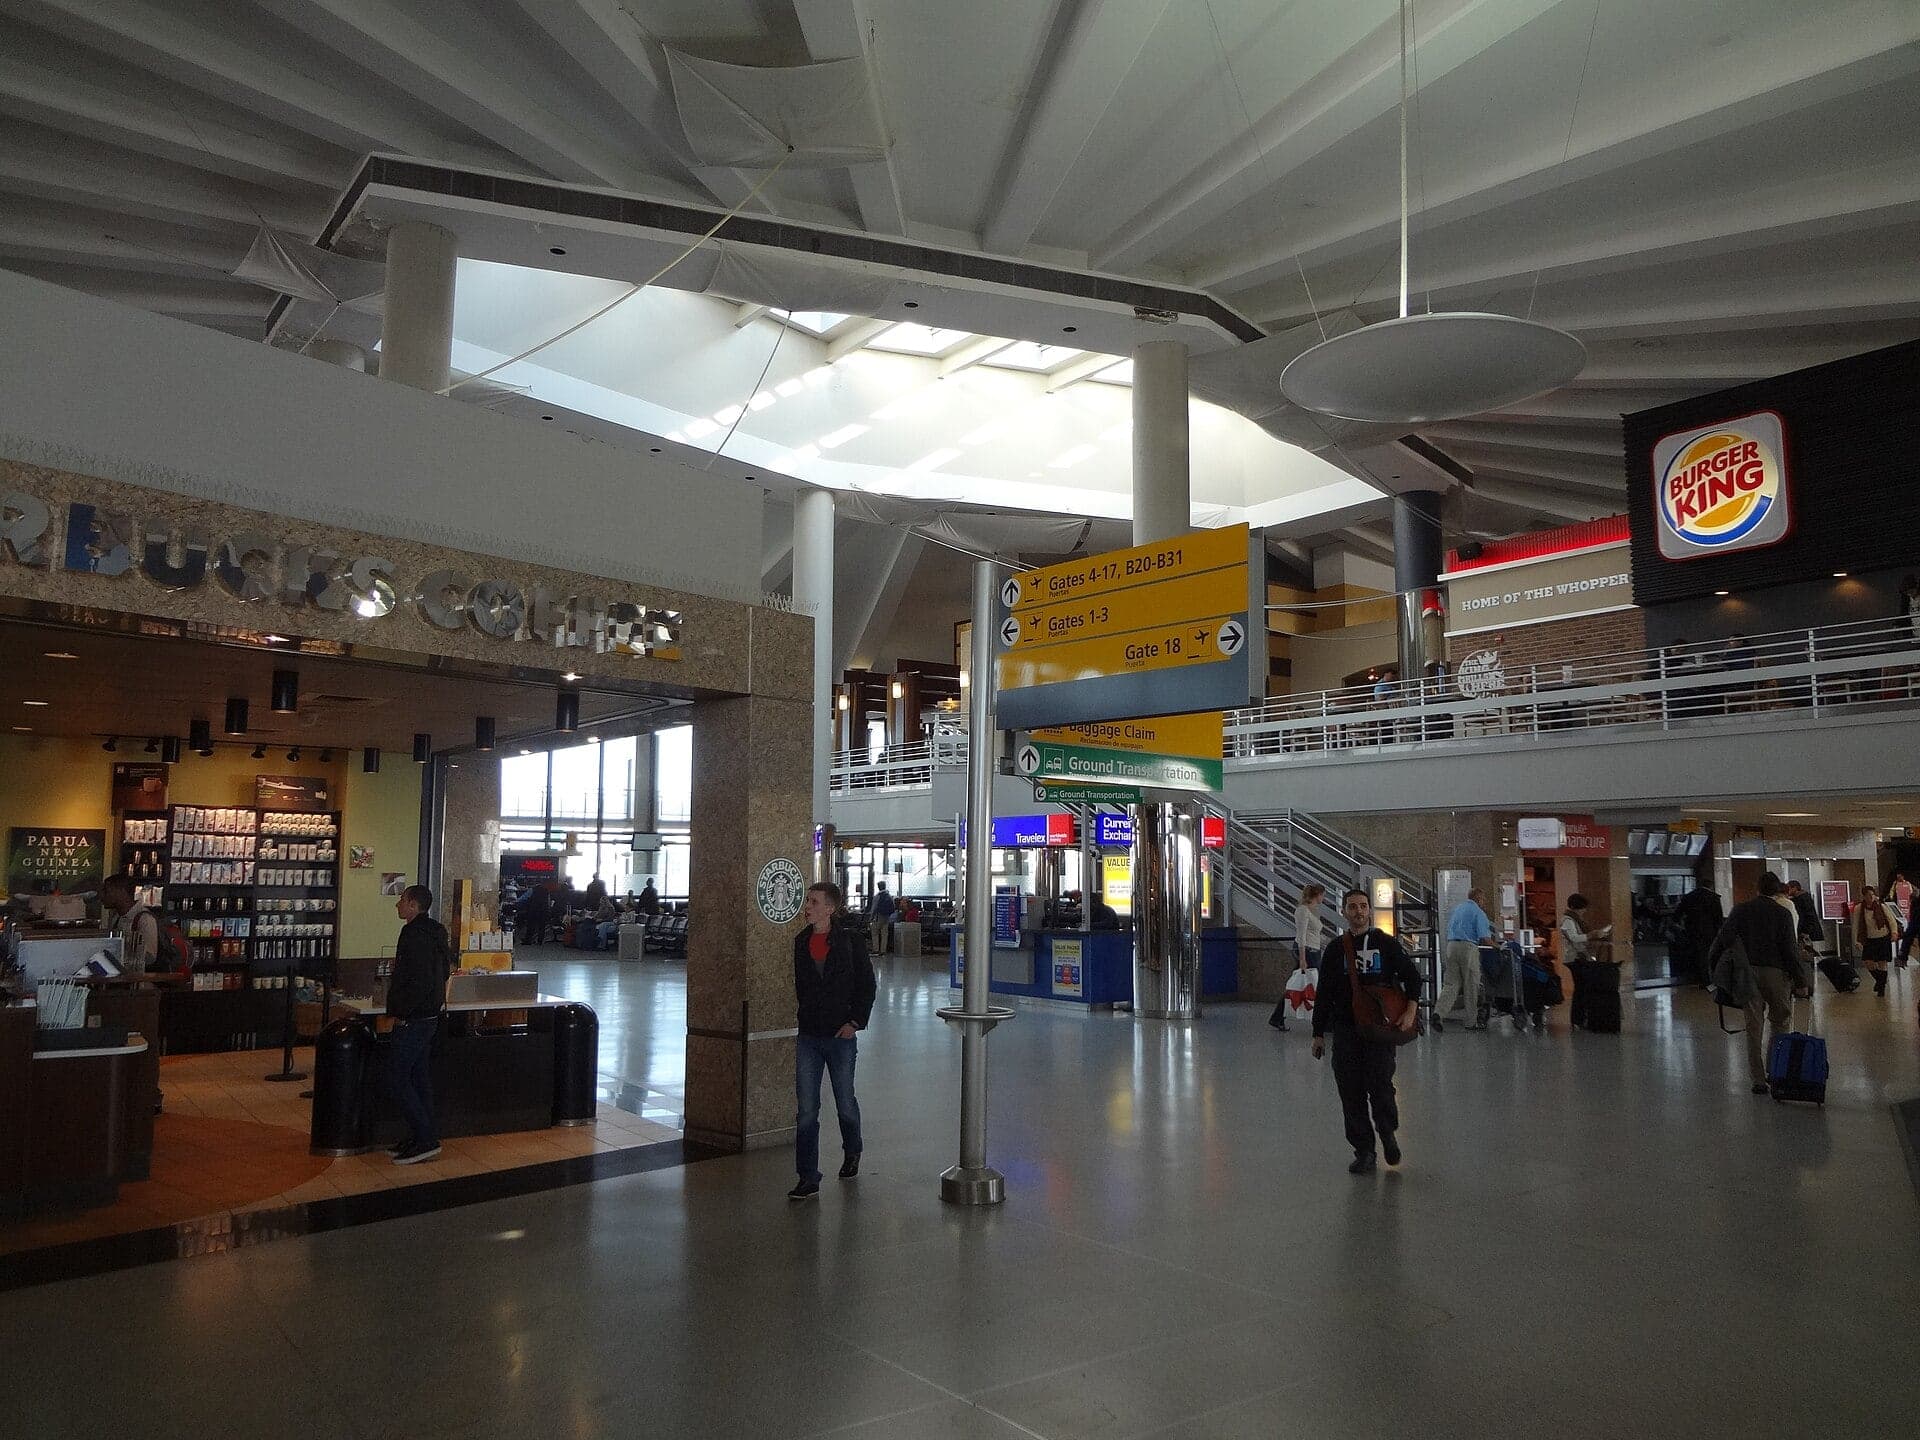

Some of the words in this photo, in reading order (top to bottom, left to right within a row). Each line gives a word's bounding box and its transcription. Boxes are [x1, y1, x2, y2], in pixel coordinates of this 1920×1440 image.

[1670, 441, 1759, 500] BURGER
[1675, 460, 1764, 528] KING
[1049, 573, 1085, 591] Gates
[1088, 563, 1121, 583] 4-17,
[1126, 549, 1183, 576] B20-B31
[1462, 595, 1500, 611] HOME
[1503, 592, 1521, 604] OF
[1524, 586, 1554, 600] THE
[1556, 573, 1629, 595] WHOPPER
[414, 568, 683, 662] COFFEE
[1048, 613, 1084, 631] Gates
[1089, 606, 1109, 624] 1-3
[1125, 643, 1159, 660] Gate
[1164, 637, 1181, 655] 18
[1124, 724, 1155, 740] Claim
[1069, 756, 1113, 773] Ground
[1060, 790, 1085, 799] Ground
[1087, 791, 1135, 801] Transportation
[27, 836, 90, 847] PAPUA
[1015, 832, 1046, 844] Travelex
[22, 857, 91, 867] GUINEA
[40, 848, 76, 856] NEW
[760, 861, 803, 890] STARBUCKS
[763, 903, 798, 920] COFFEE
